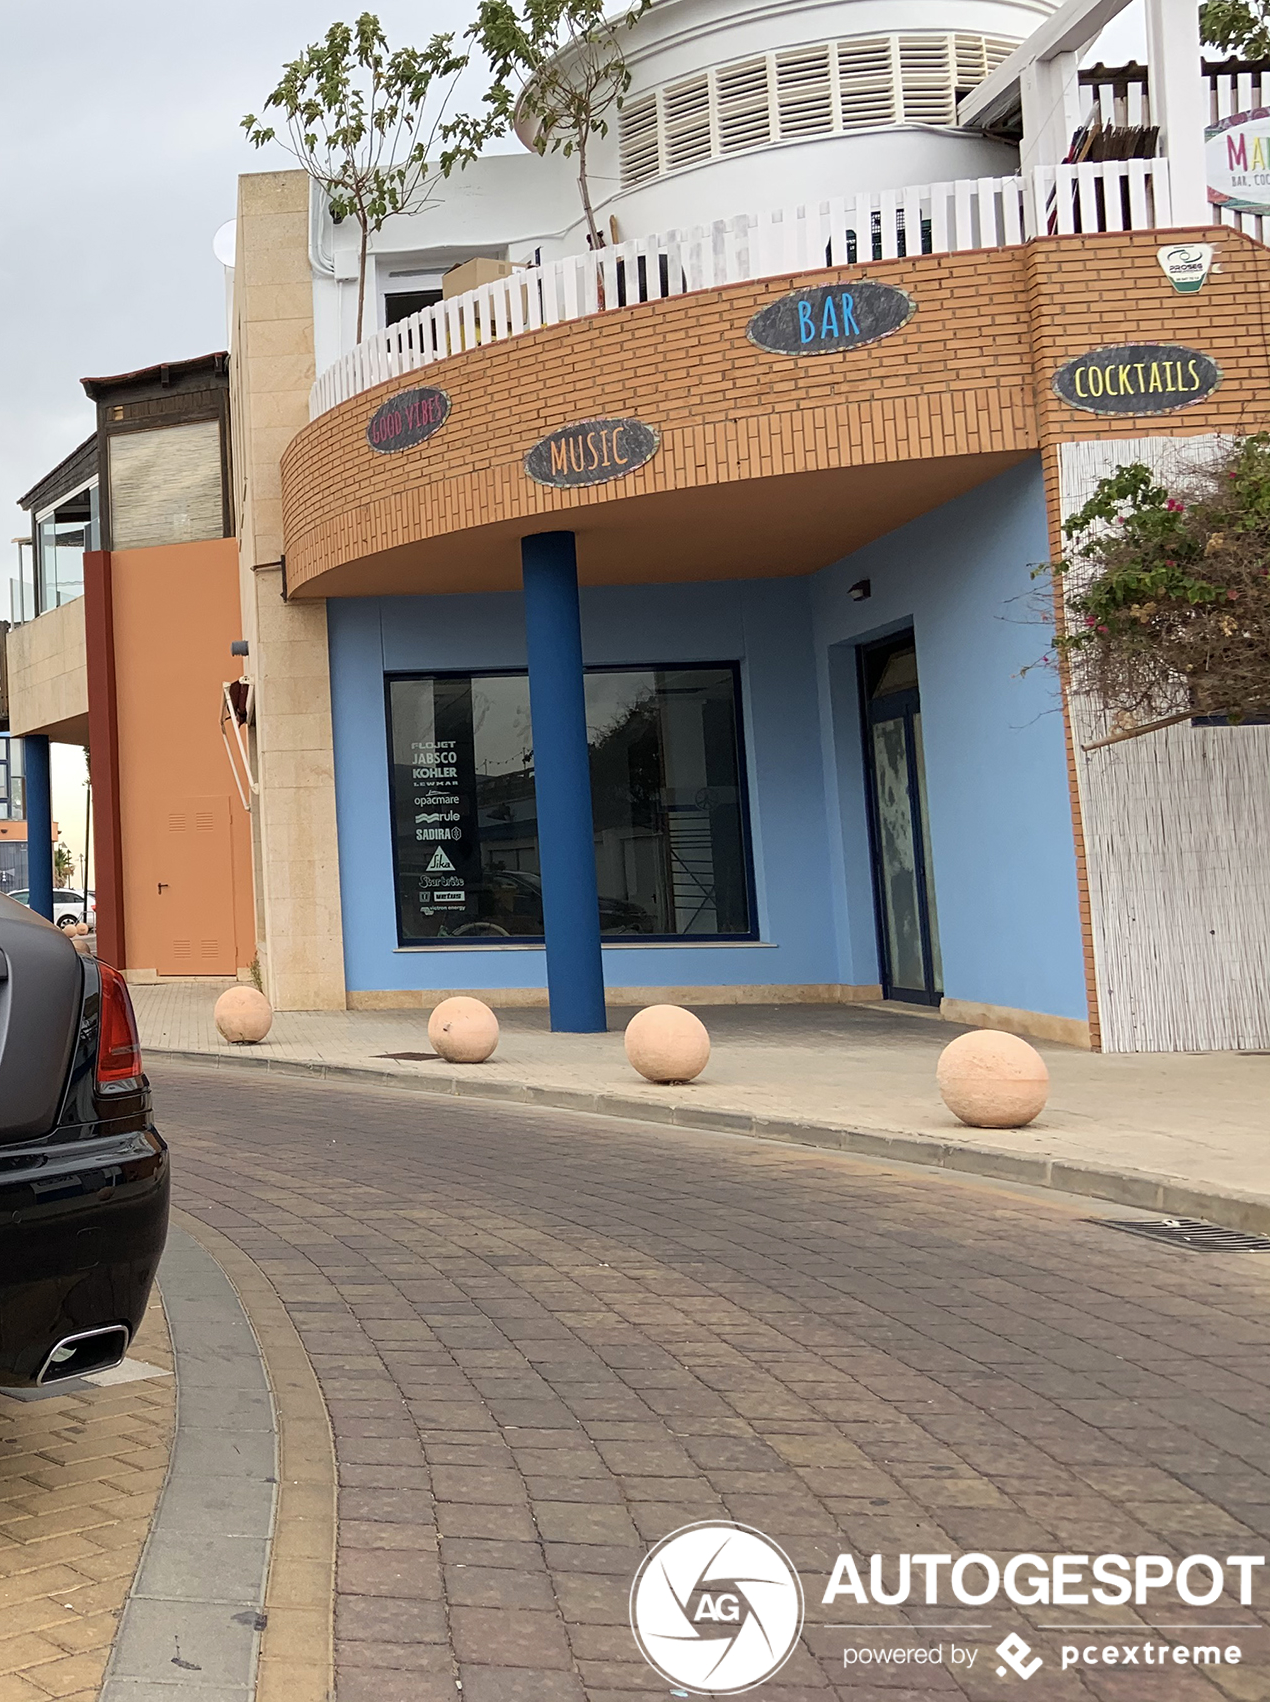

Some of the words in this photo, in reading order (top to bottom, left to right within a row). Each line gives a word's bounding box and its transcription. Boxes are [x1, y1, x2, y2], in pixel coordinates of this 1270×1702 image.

[797, 292, 860, 344] BAR
[1074, 359, 1200, 398] COCKTAILS
[372, 411, 402, 444] GOOD
[405, 395, 442, 430] VIBES
[550, 427, 628, 476] MUSIC
[411, 741, 456, 749] FLOJET
[412, 752, 457, 764] JABSCO
[412, 767, 458, 778] KOHLER
[414, 796, 460, 807] opacmare
[439, 810, 461, 821] rule
[416, 828, 451, 840] SADIRA
[431, 854, 451, 869] Sika
